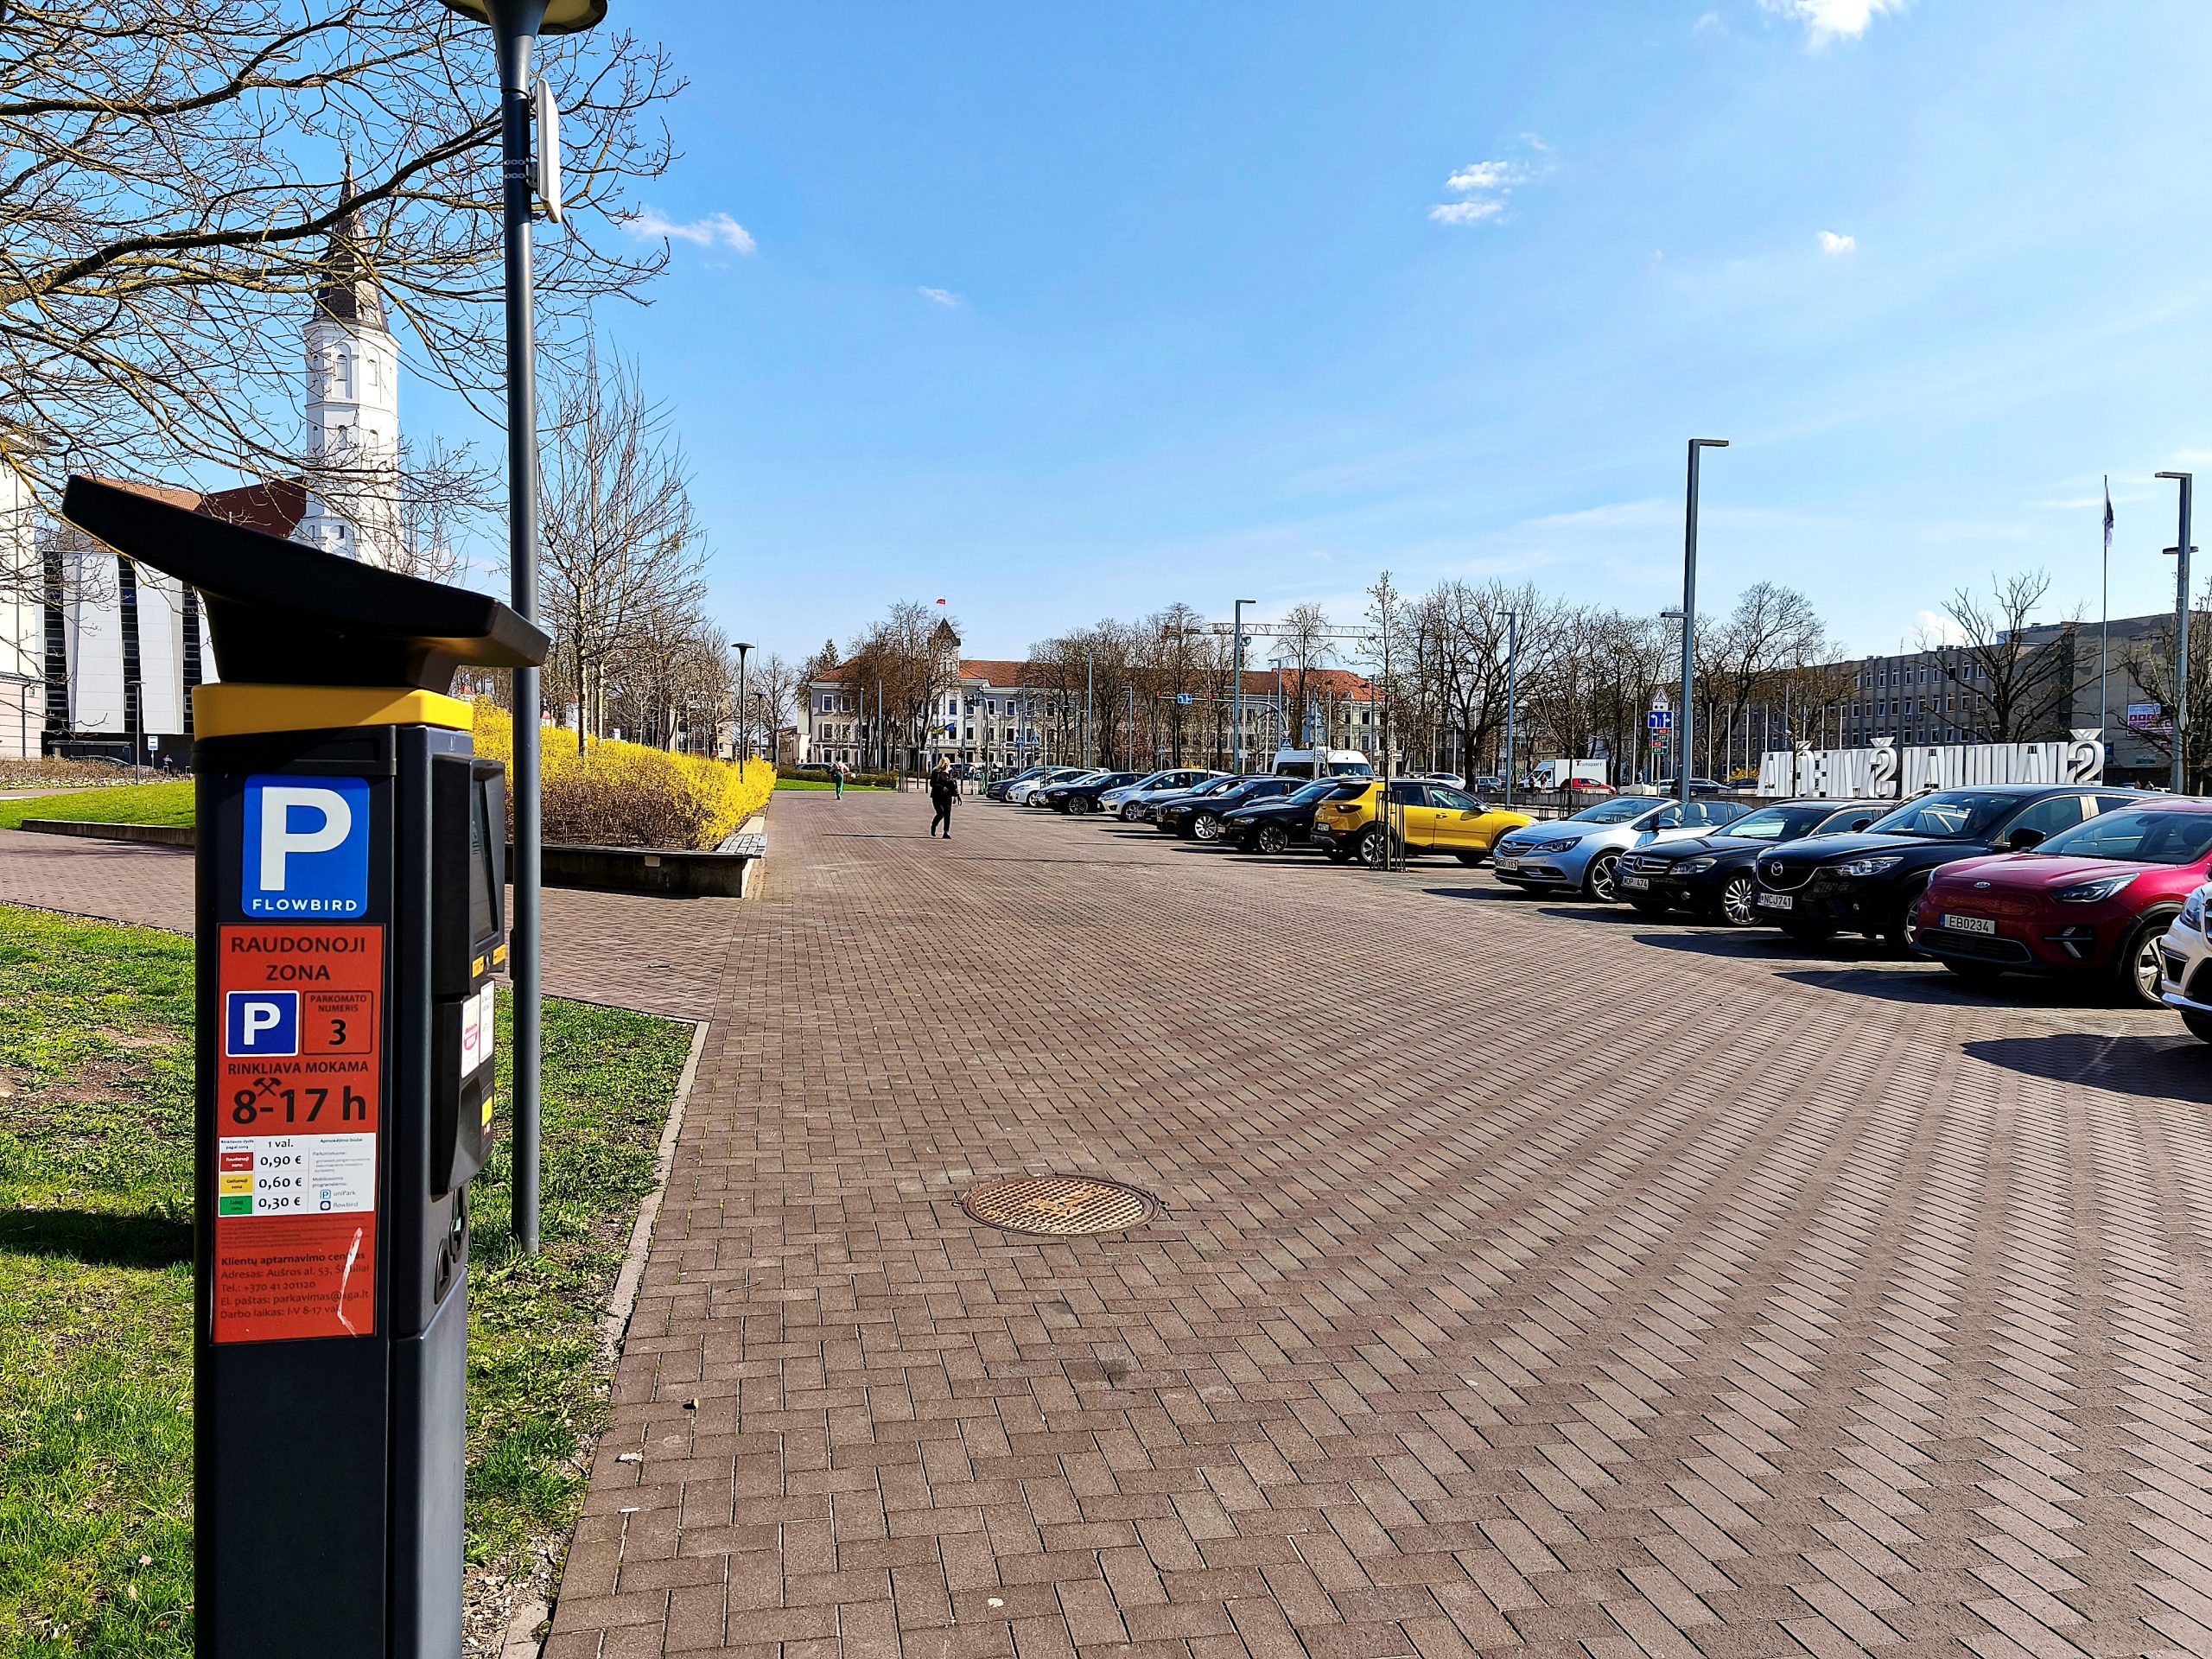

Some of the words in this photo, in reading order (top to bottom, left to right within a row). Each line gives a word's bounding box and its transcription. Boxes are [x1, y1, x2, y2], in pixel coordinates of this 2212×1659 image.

[260, 786, 352, 891] P
[252, 899, 358, 912] FLOWBIRD
[1949, 916, 1989, 932] EB0234
[231, 937, 365, 953] RAUDONOJI
[266, 964, 331, 981] ZONA
[310, 995, 366, 1003] PARKOMATO
[318, 1004, 359, 1013] NUMERIS
[244, 1002, 281, 1046] P
[328, 1019, 346, 1046] 3
[228, 1062, 302, 1075] RINKLIAVA
[305, 1060, 369, 1073] MOKAMA
[232, 1088, 328, 1124] 8-17
[342, 1085, 366, 1121] h
[275, 1139, 294, 1147] val.
[260, 1155, 290, 1167] 0,90
[295, 1155, 302, 1164] €
[259, 1177, 290, 1190] 0,60
[296, 1178, 302, 1186] €
[258, 1198, 289, 1210] 0,30
[294, 1197, 301, 1206] €
[221, 1257, 257, 1267] Klientų
[261, 1253, 325, 1266] aptarnavimo
[221, 1270, 264, 1279] Adresas:
[266, 1268, 301, 1277] Aušros
[304, 1267, 315, 1275] al.
[318, 1268, 333, 1276] 53,
[222, 1283, 241, 1292] Tel.:
[245, 1284, 268, 1293] +370
[220, 1297, 232, 1306] El.
[235, 1296, 270, 1306] paštas:
[220, 1310, 251, 1319] Darbo
[253, 1307, 283, 1318] laikas:
[303, 1306, 321, 1315] 8-17
